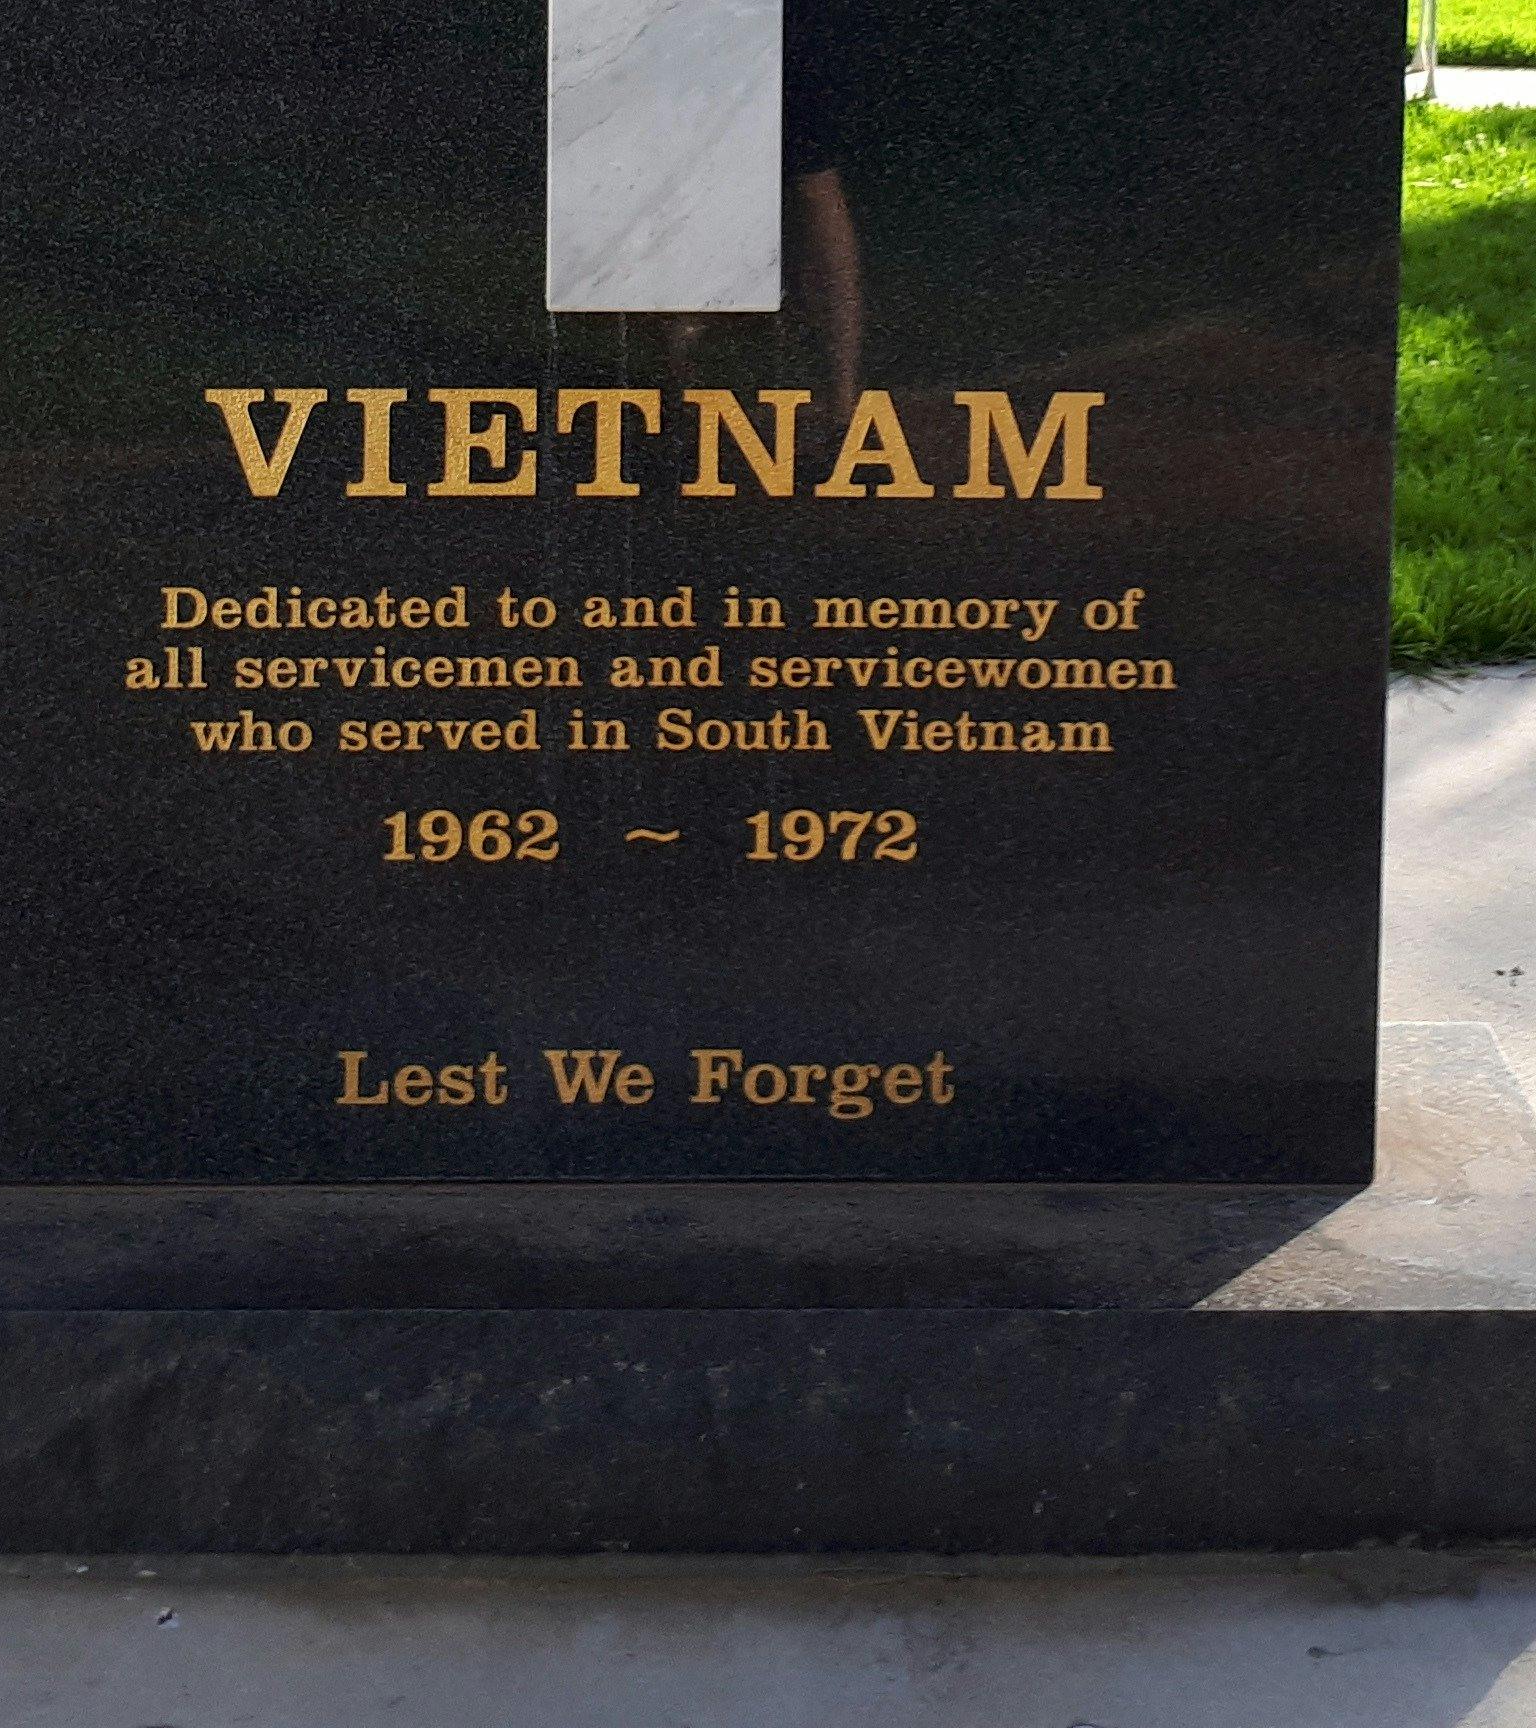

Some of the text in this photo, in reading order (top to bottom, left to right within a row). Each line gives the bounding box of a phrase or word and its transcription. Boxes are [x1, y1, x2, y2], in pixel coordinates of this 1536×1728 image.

[204, 387, 1106, 501] VIETNAM
[161, 585, 1146, 642] Dedicated to and in memory of
[124, 645, 1176, 691] all servicemen and servicewomen
[190, 707, 1113, 753] who served in South Vietnam
[384, 809, 560, 862] 1962
[747, 809, 918, 862] 1972
[339, 1049, 954, 1119] Lest We Forget
